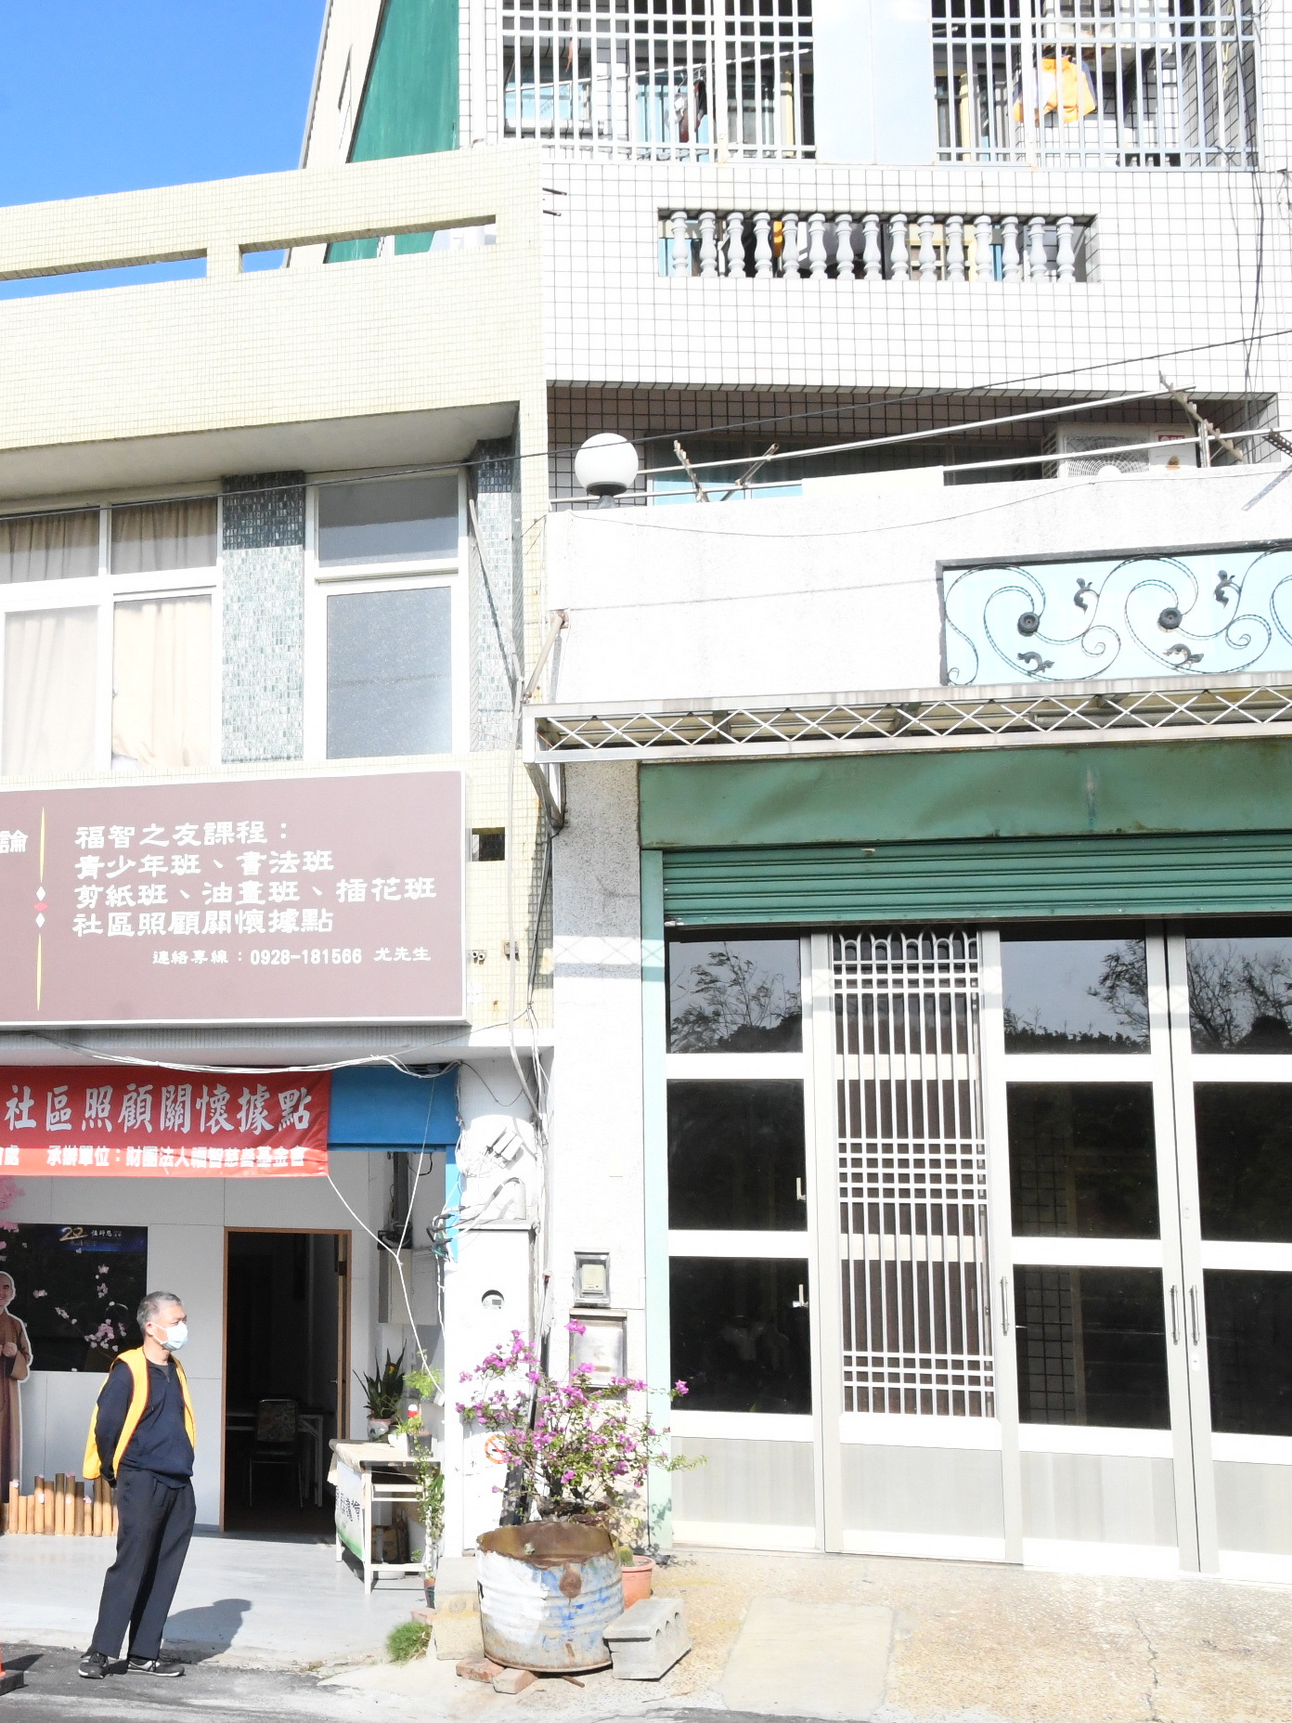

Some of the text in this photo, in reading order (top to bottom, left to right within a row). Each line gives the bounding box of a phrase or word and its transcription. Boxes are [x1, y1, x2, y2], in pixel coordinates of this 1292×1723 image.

[74, 820, 288, 850] 福智之友課程：
[74, 850, 334, 880] 青少年班、書法班
[72, 908, 334, 938] 社區照顧關懷據點
